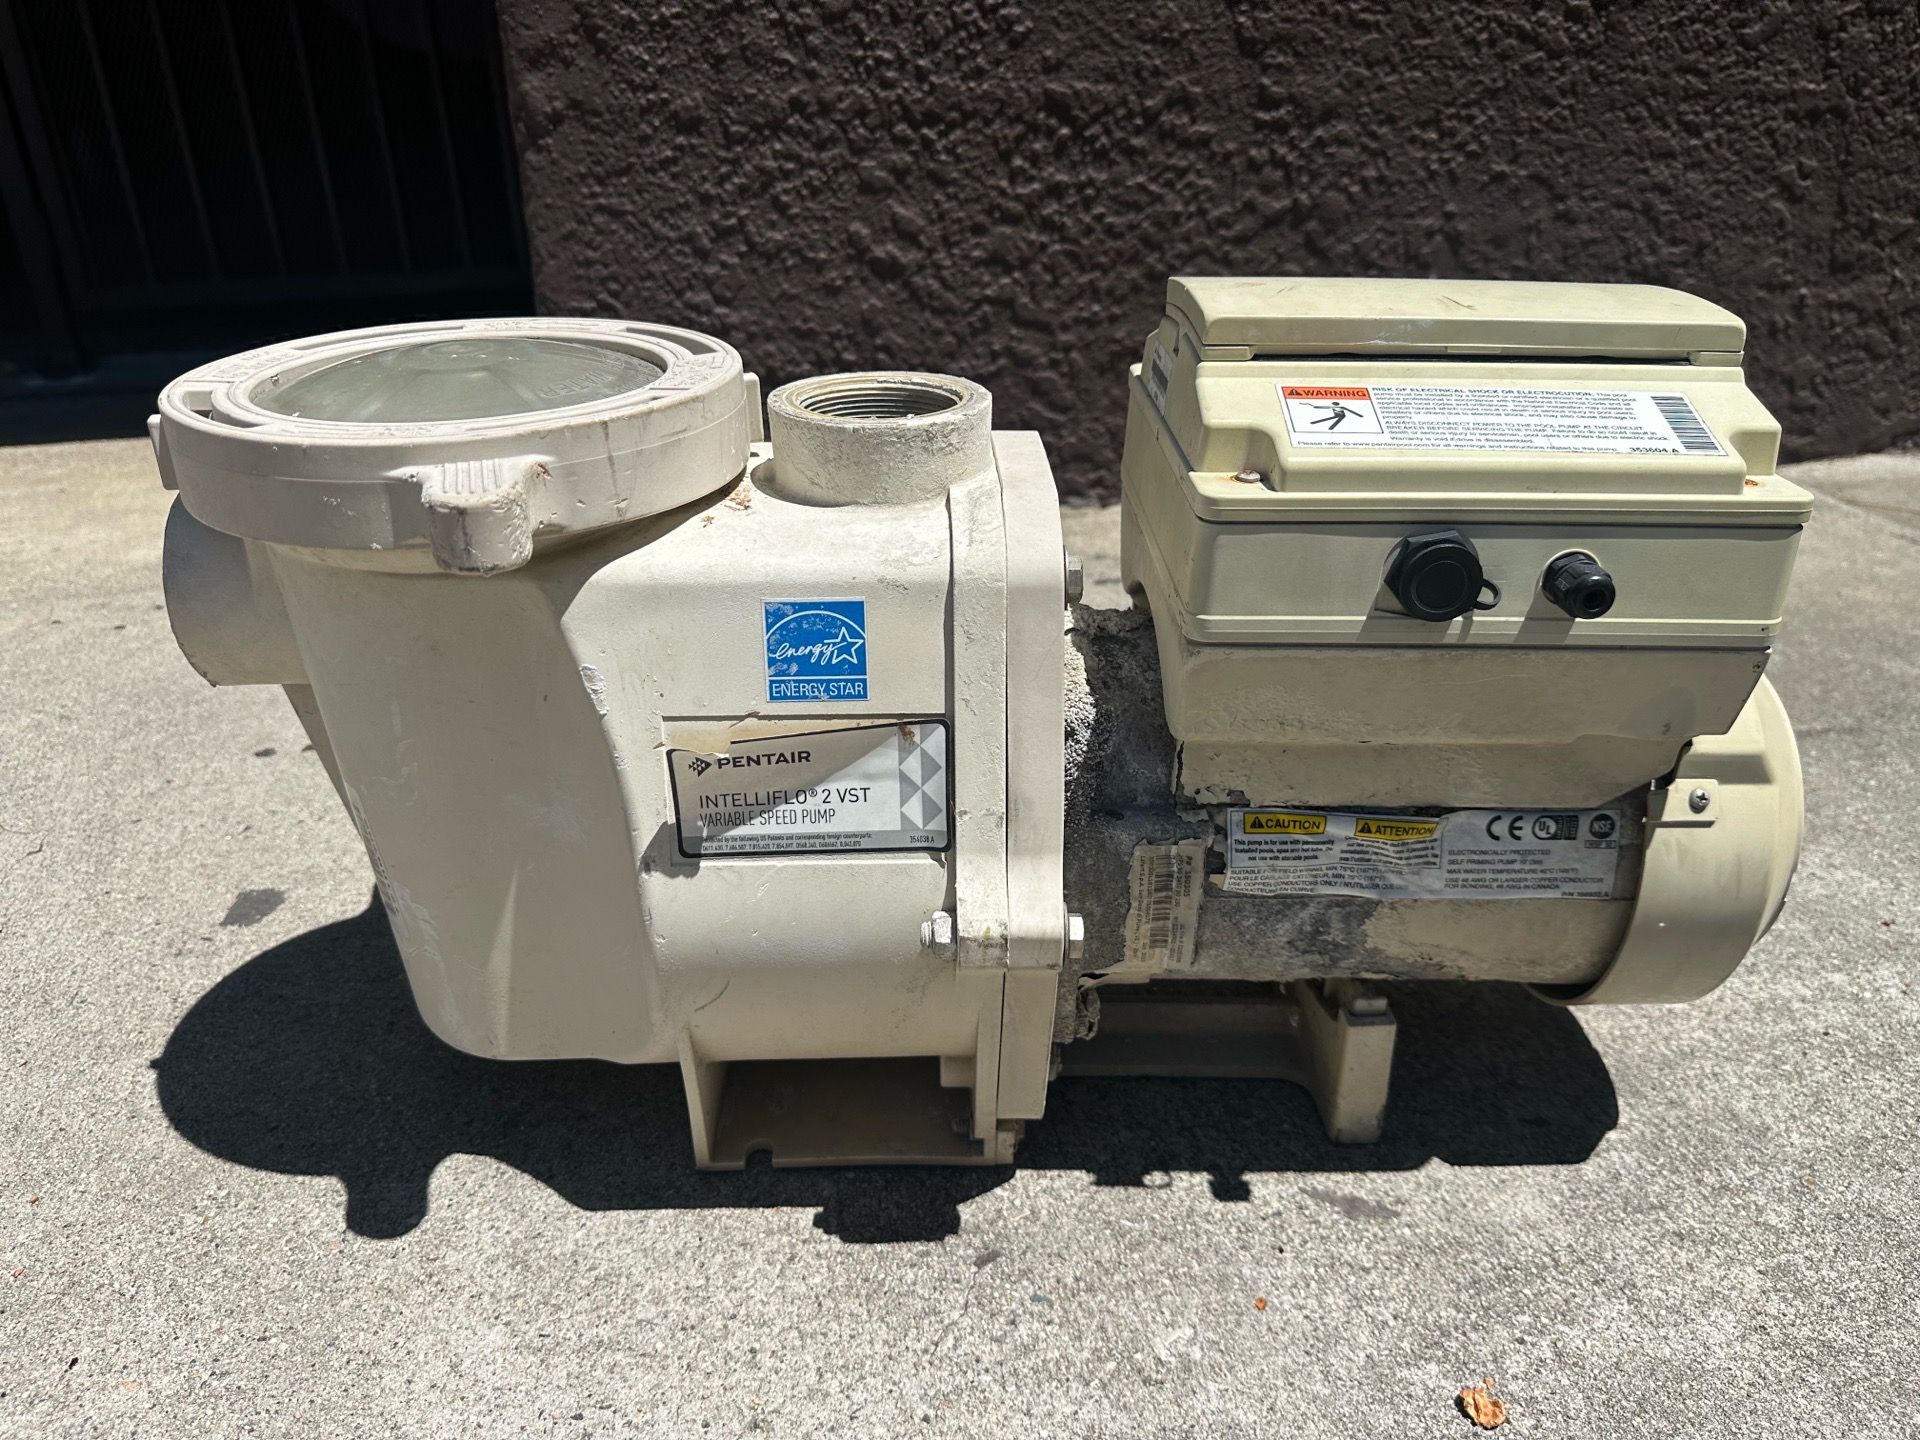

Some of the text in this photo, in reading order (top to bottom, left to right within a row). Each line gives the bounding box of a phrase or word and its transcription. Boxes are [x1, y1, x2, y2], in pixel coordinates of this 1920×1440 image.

[1302, 389, 1366, 398] WARNING
[769, 643, 833, 666] energy
[773, 682, 863, 696] ENERGY STAR
[718, 751, 811, 769] PENTAIR
[822, 788, 832, 804] 2
[835, 787, 870, 803] VST
[700, 808, 836, 827] VARIABLE SPEED PUMP
[1266, 818, 1321, 830] CAUTION
[1374, 824, 1434, 837] ATTENTION
[1592, 820, 1612, 833] NSF
[795, 834, 825, 842] corresponding
